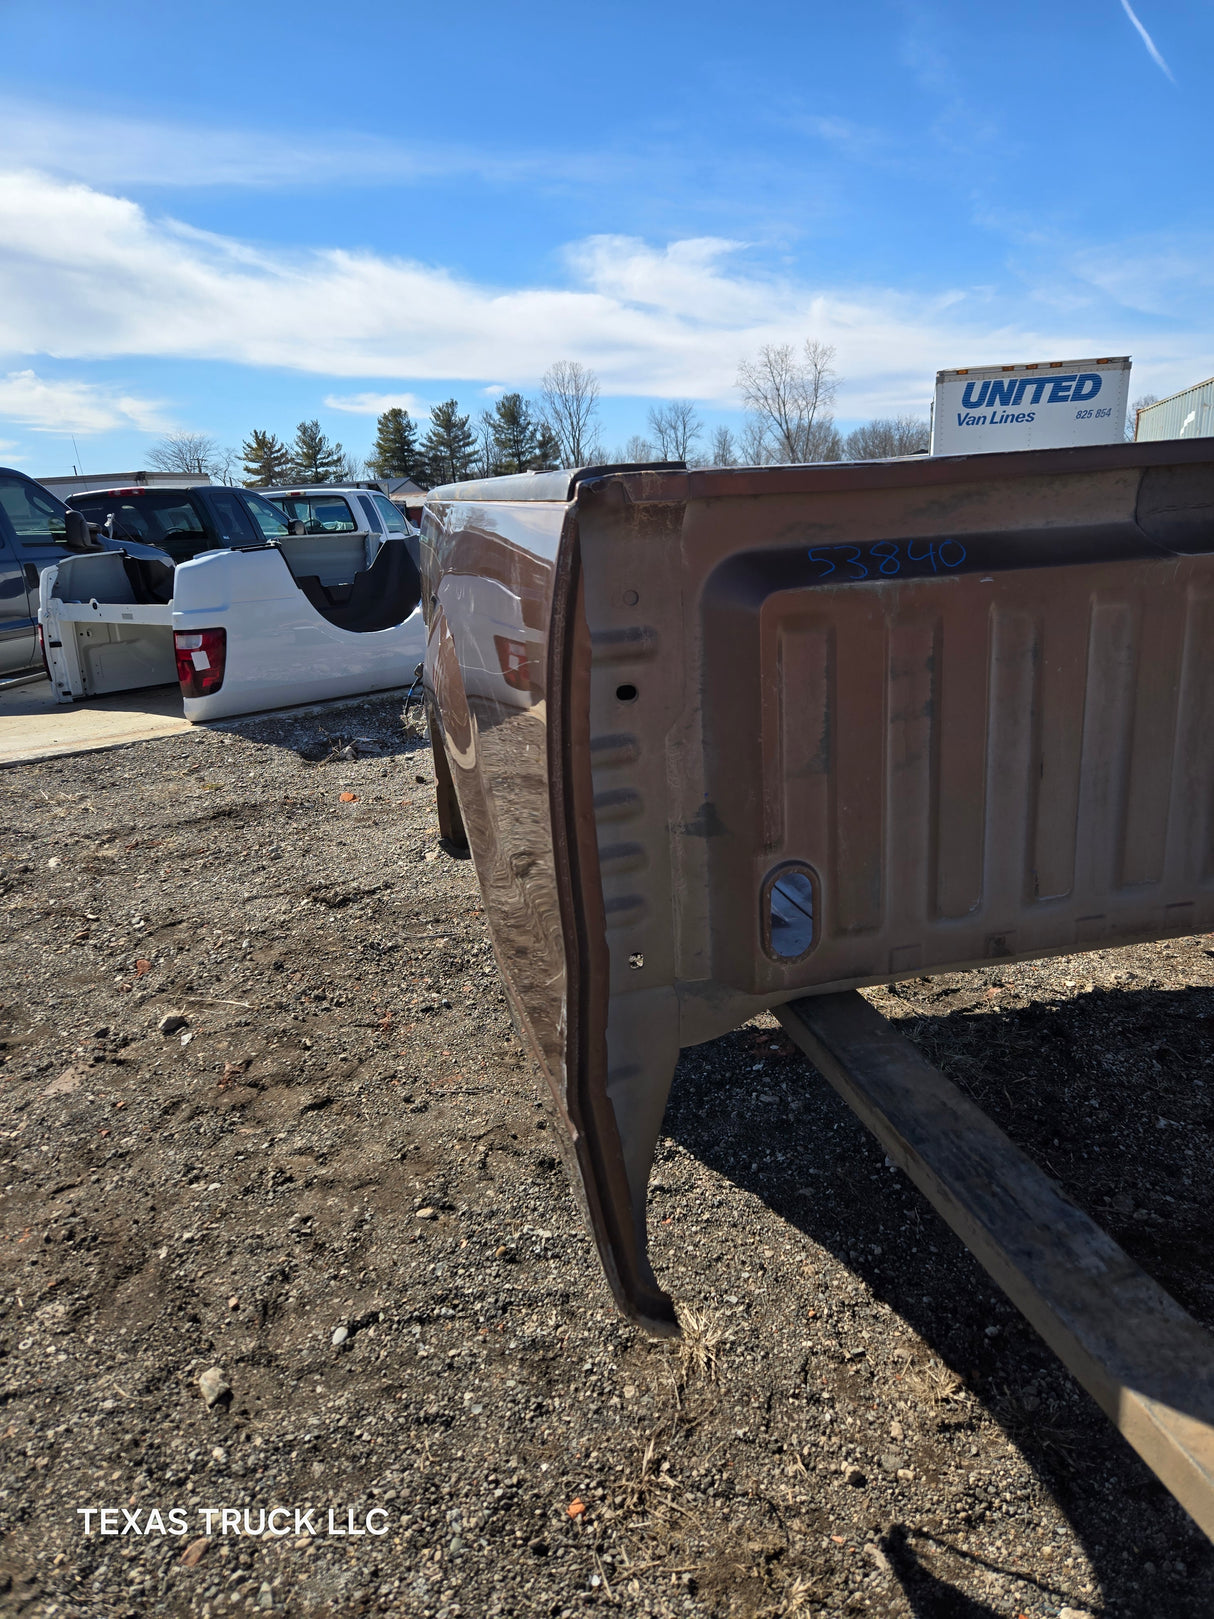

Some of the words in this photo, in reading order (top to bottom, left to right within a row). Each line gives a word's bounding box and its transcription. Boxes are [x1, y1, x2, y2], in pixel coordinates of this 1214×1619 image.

[961, 373, 1103, 409] UNITED
[957, 412, 987, 426] Van
[989, 410, 1036, 425] Lines
[1075, 409, 1093, 420] 825
[1095, 407, 1113, 418] 854
[808, 539, 966, 579] 53840
